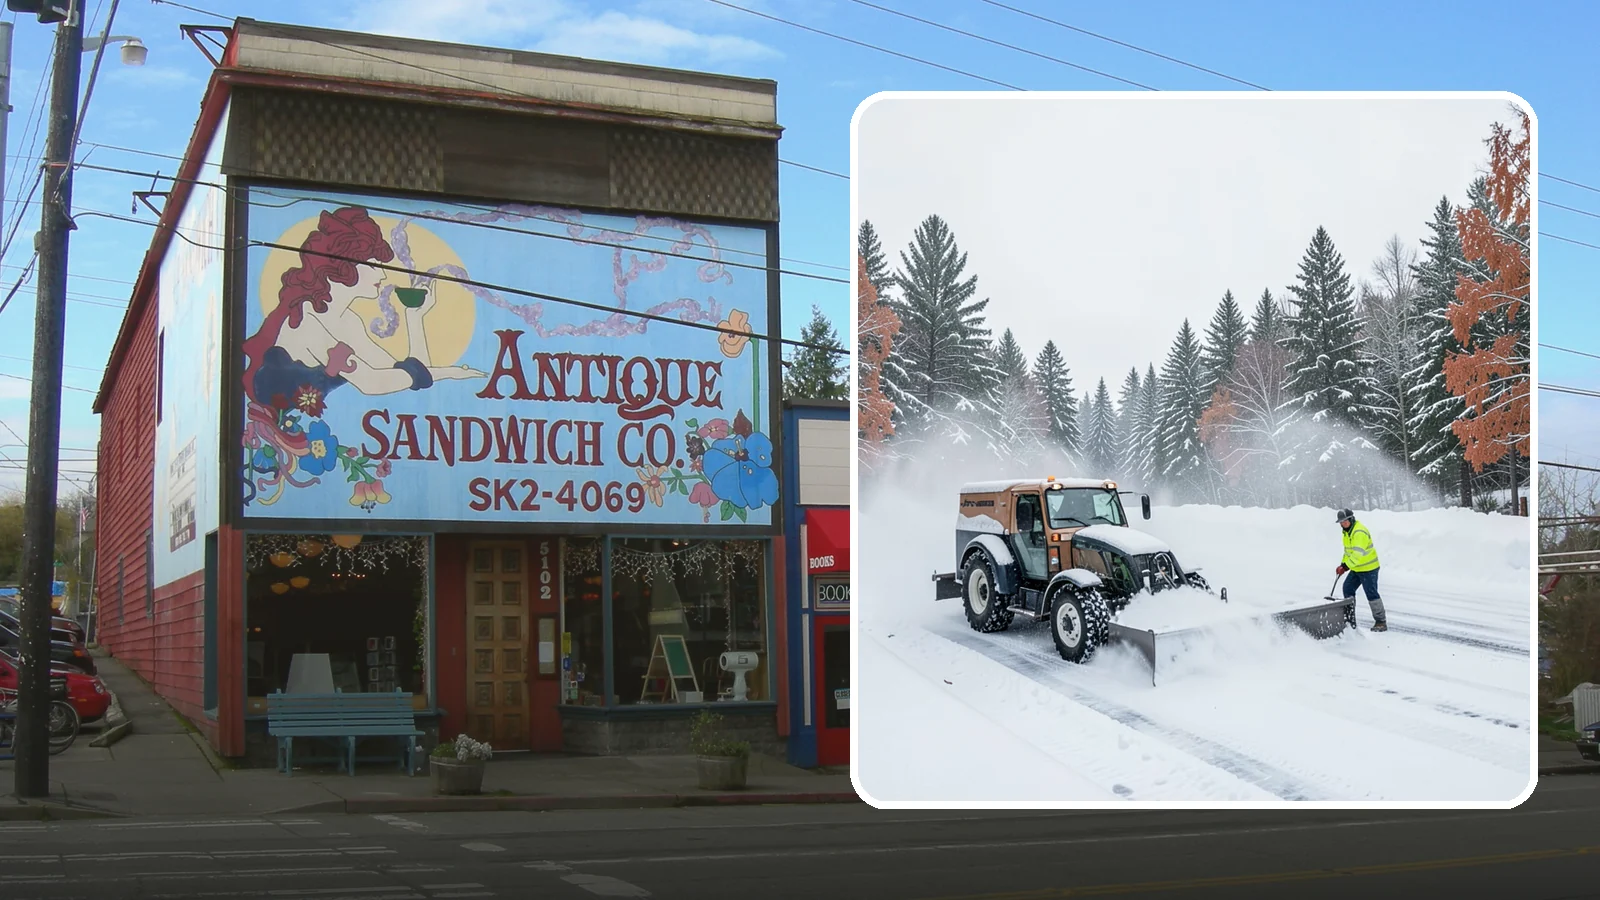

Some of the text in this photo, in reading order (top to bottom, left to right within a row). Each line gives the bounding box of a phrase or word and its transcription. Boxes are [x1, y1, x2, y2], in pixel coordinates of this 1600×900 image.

[475, 329, 724, 421] ANTIQUE
[361, 408, 685, 469] SANDWICH CO.
[468, 477, 645, 513] SK2-4069
[540, 541, 551, 600] 5102
[809, 555, 835, 569] BOOKS
